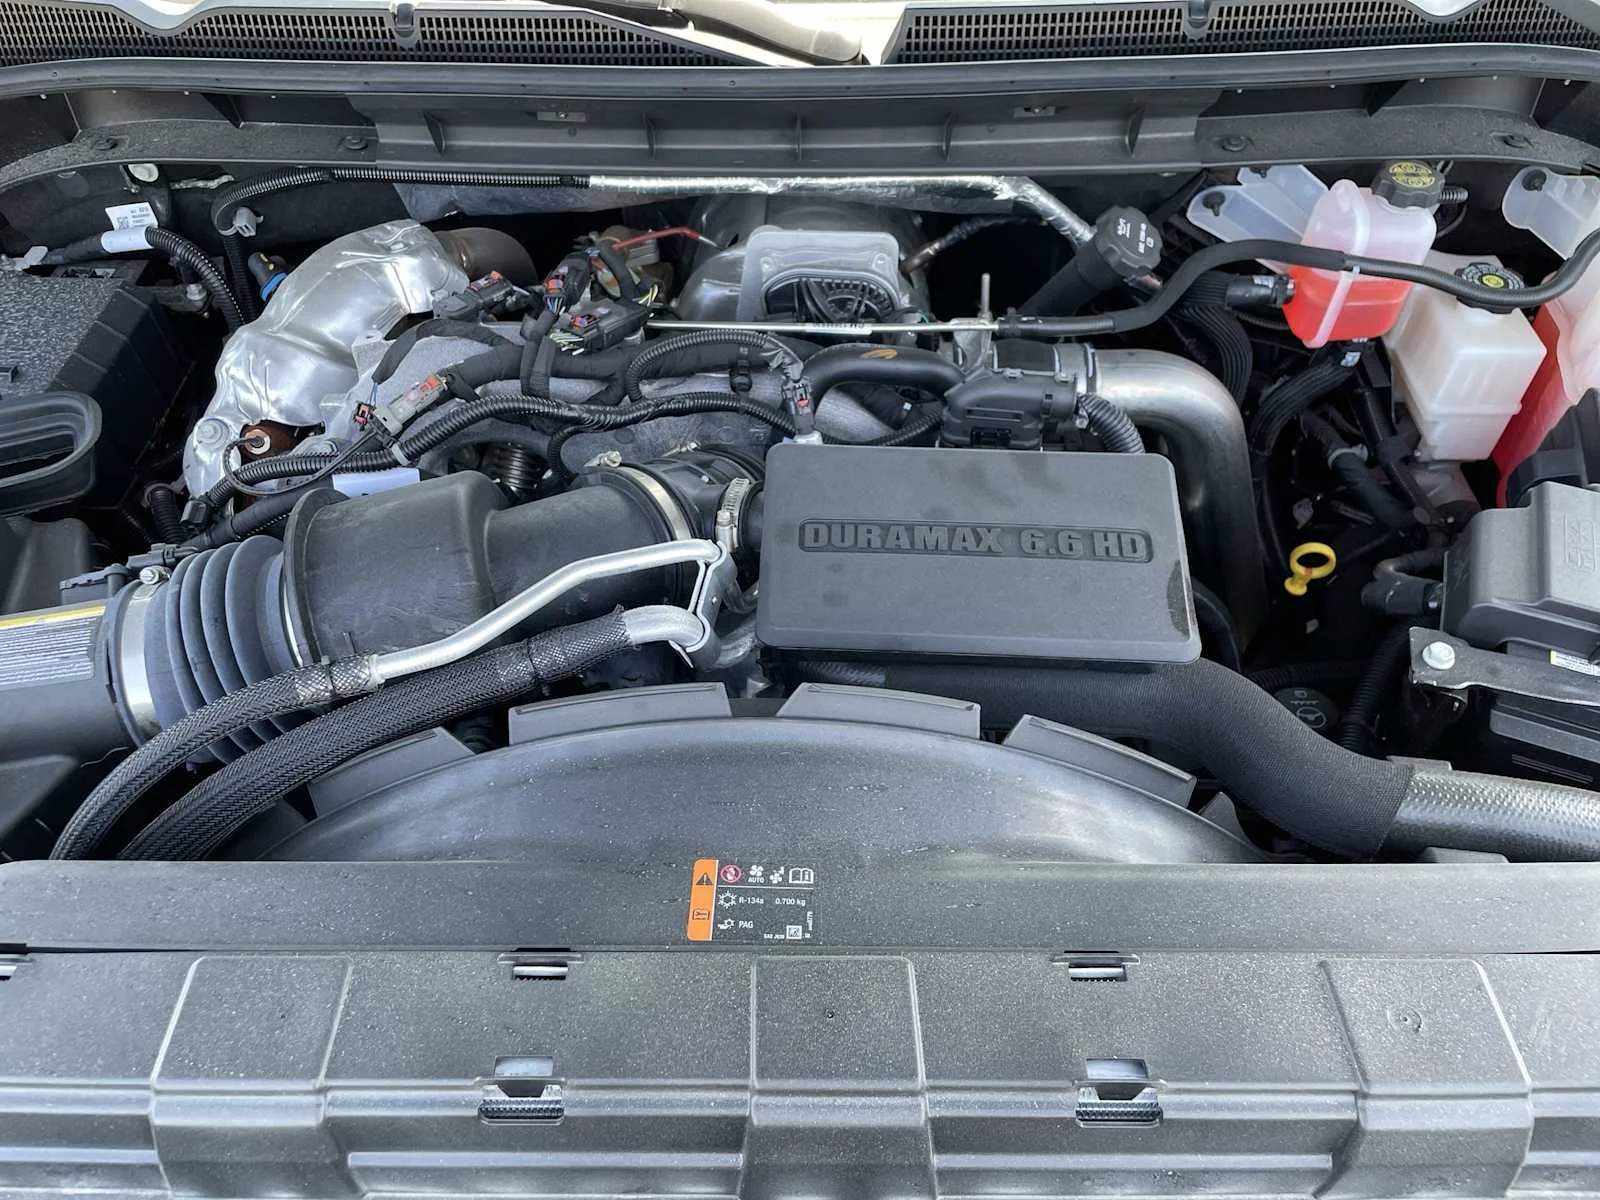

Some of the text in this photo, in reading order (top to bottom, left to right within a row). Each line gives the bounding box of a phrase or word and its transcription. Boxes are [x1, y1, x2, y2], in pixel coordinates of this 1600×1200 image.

[803, 523, 1147, 559] DURAMAX 6.6 HD
[797, 898, 806, 907] kg
[739, 921, 754, 929] PAG
